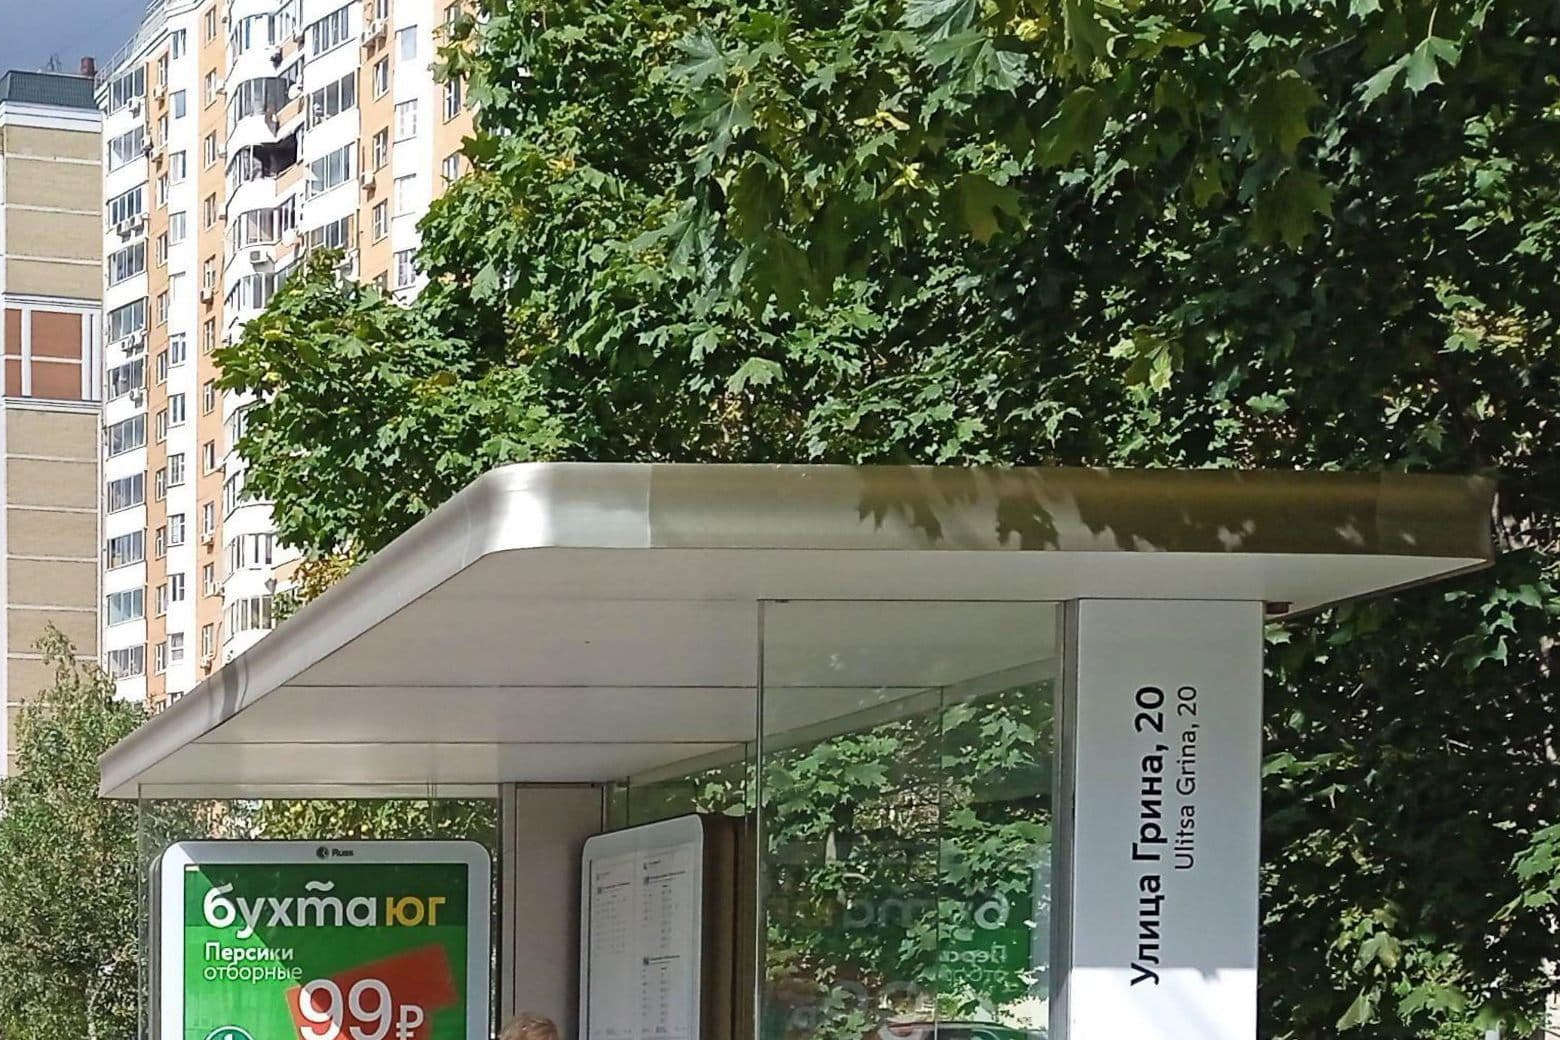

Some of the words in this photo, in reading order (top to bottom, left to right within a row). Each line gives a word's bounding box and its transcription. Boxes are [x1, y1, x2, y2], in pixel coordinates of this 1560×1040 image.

[1134, 685, 1164, 733] 20
[1177, 685, 1197, 716] 20
[1176, 724, 1200, 795] Grina,
[1132, 744, 1169, 862] Грина,
[1175, 805, 1196, 870] Ulitsa
[203, 880, 377, 938] бухта
[386, 896, 446, 927] юг
[1130, 874, 1165, 986] Улица
[203, 962, 303, 985] отборные
[205, 942, 294, 964] Персики
